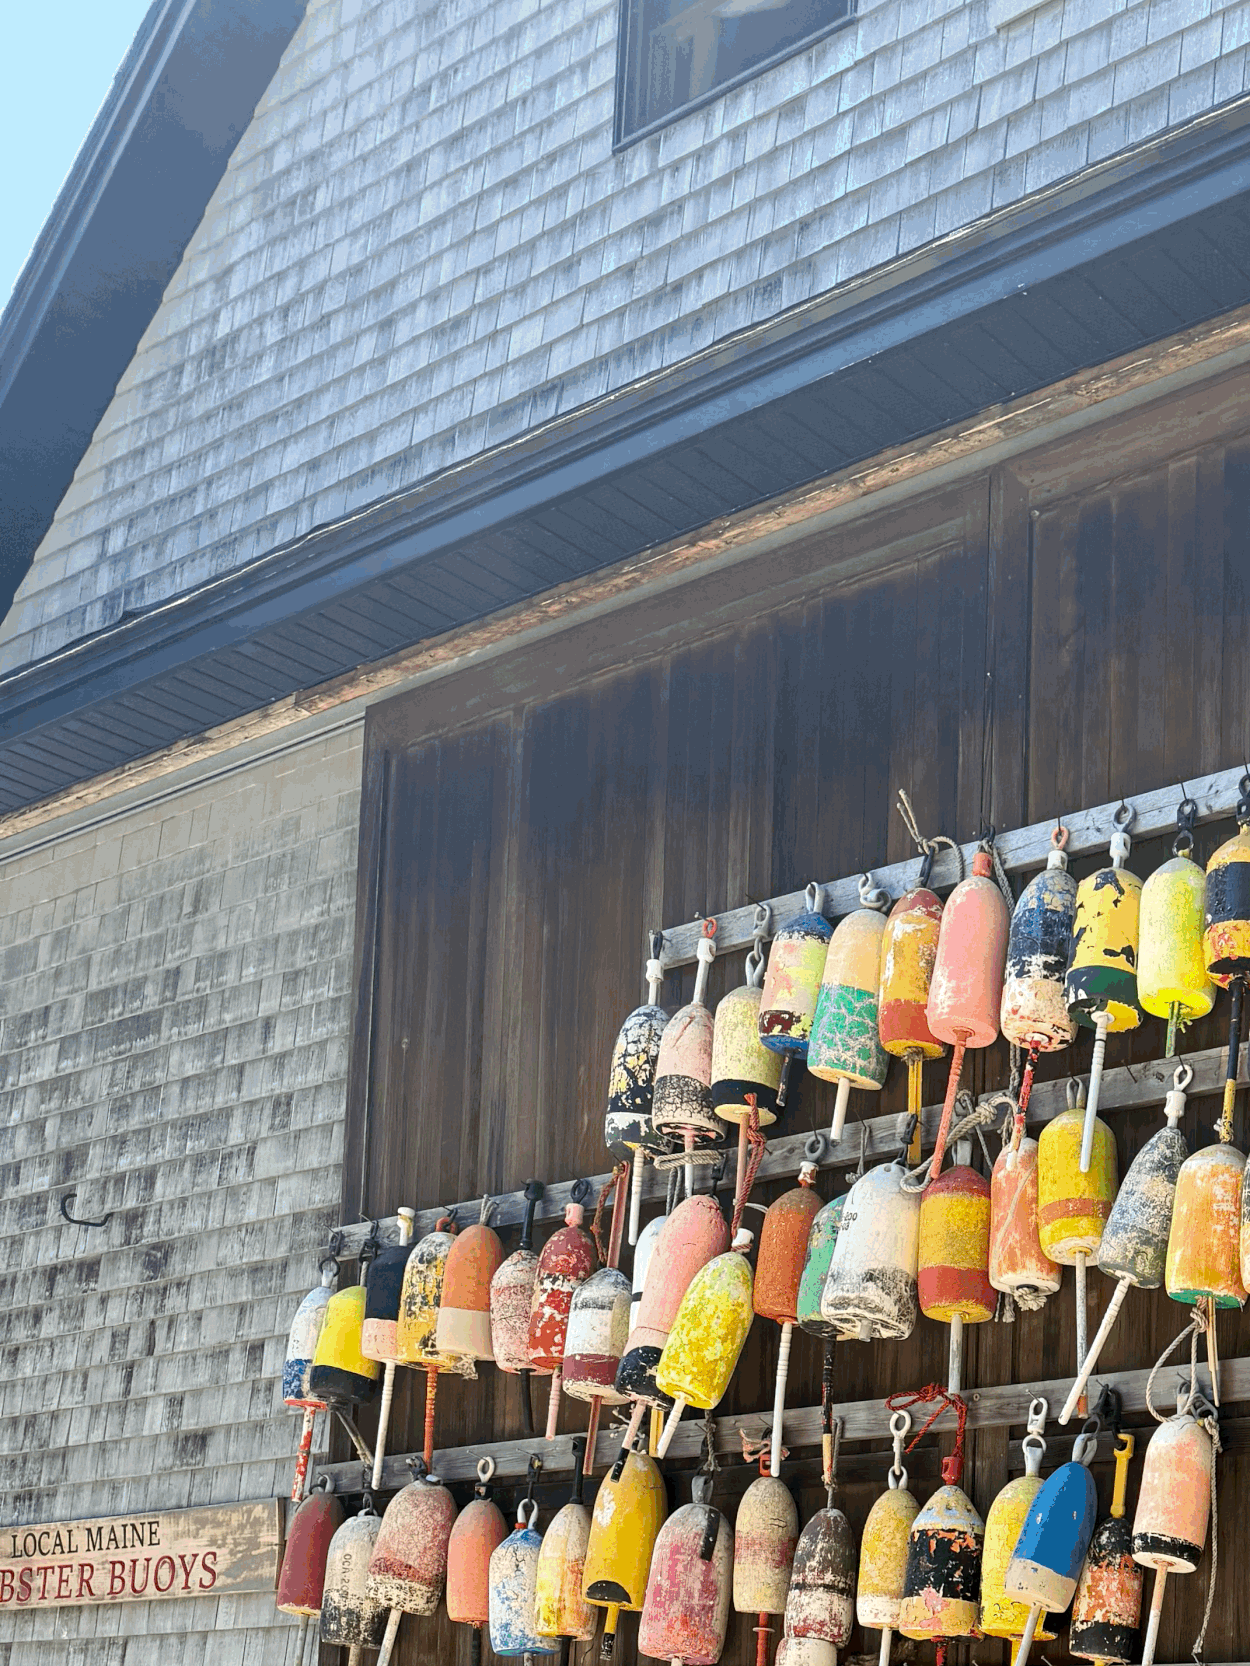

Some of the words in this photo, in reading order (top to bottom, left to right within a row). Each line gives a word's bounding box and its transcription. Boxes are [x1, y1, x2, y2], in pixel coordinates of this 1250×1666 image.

[11, 1529, 79, 1559] LOCAL
[85, 1521, 161, 1552] MAINE
[0, 1562, 96, 1604] BSTER
[107, 1551, 218, 1596] BUOYS
